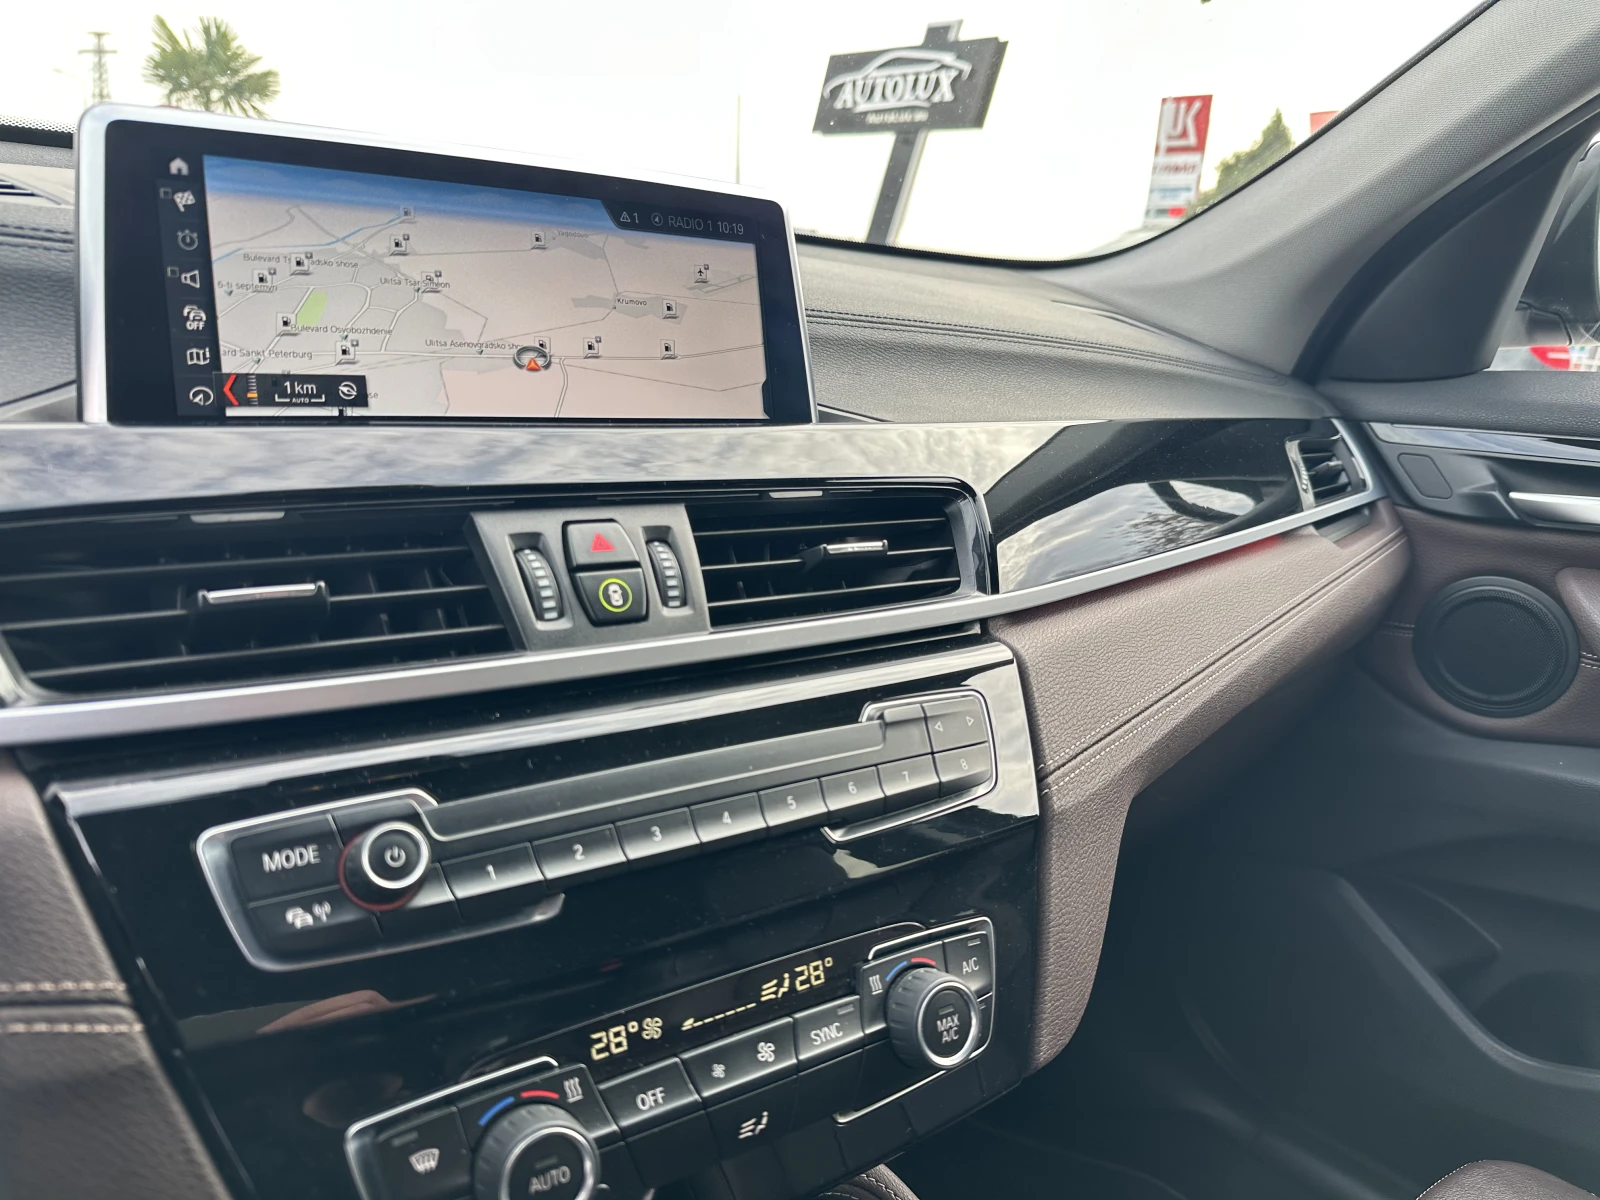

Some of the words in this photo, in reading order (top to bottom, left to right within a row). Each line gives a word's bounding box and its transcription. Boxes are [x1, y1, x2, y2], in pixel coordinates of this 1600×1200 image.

[833, 69, 957, 109] AUTOLUX
[668, 215, 703, 231] RADIO
[717, 221, 744, 235] 10:19
[243, 254, 280, 263] Bulevard
[335, 260, 359, 268] shose
[379, 277, 402, 286] Ulitsa
[405, 278, 421, 287] Tsar
[422, 280, 451, 289] Simeon
[617, 298, 648, 307] Krumovo
[186, 320, 205, 331] OFF
[290, 323, 328, 333] Bulevard
[330, 325, 393, 336] Osvobozhdenie
[425, 338, 448, 347] Ulitsa
[450, 339, 506, 350] Asenovgradsko
[239, 350, 265, 358] Sankt
[268, 350, 313, 360] Peterburg
[283, 381, 291, 395] 1
[294, 381, 317, 395] km
[959, 757, 969, 771] 8
[901, 771, 911, 783] 7
[847, 780, 859, 796] 6
[786, 796, 798, 810] 5
[722, 811, 733, 825] 4
[650, 825, 664, 843] 3
[262, 844, 321, 873] MODE
[572, 844, 585, 861] 2
[486, 864, 496, 881] 1
[962, 956, 981, 976] A/C
[936, 1014, 961, 1032] MAX
[810, 1021, 844, 1047] SYNC
[941, 1028, 961, 1045] A/C
[636, 1087, 666, 1112] OFF
[528, 1165, 572, 1194] AUTO
